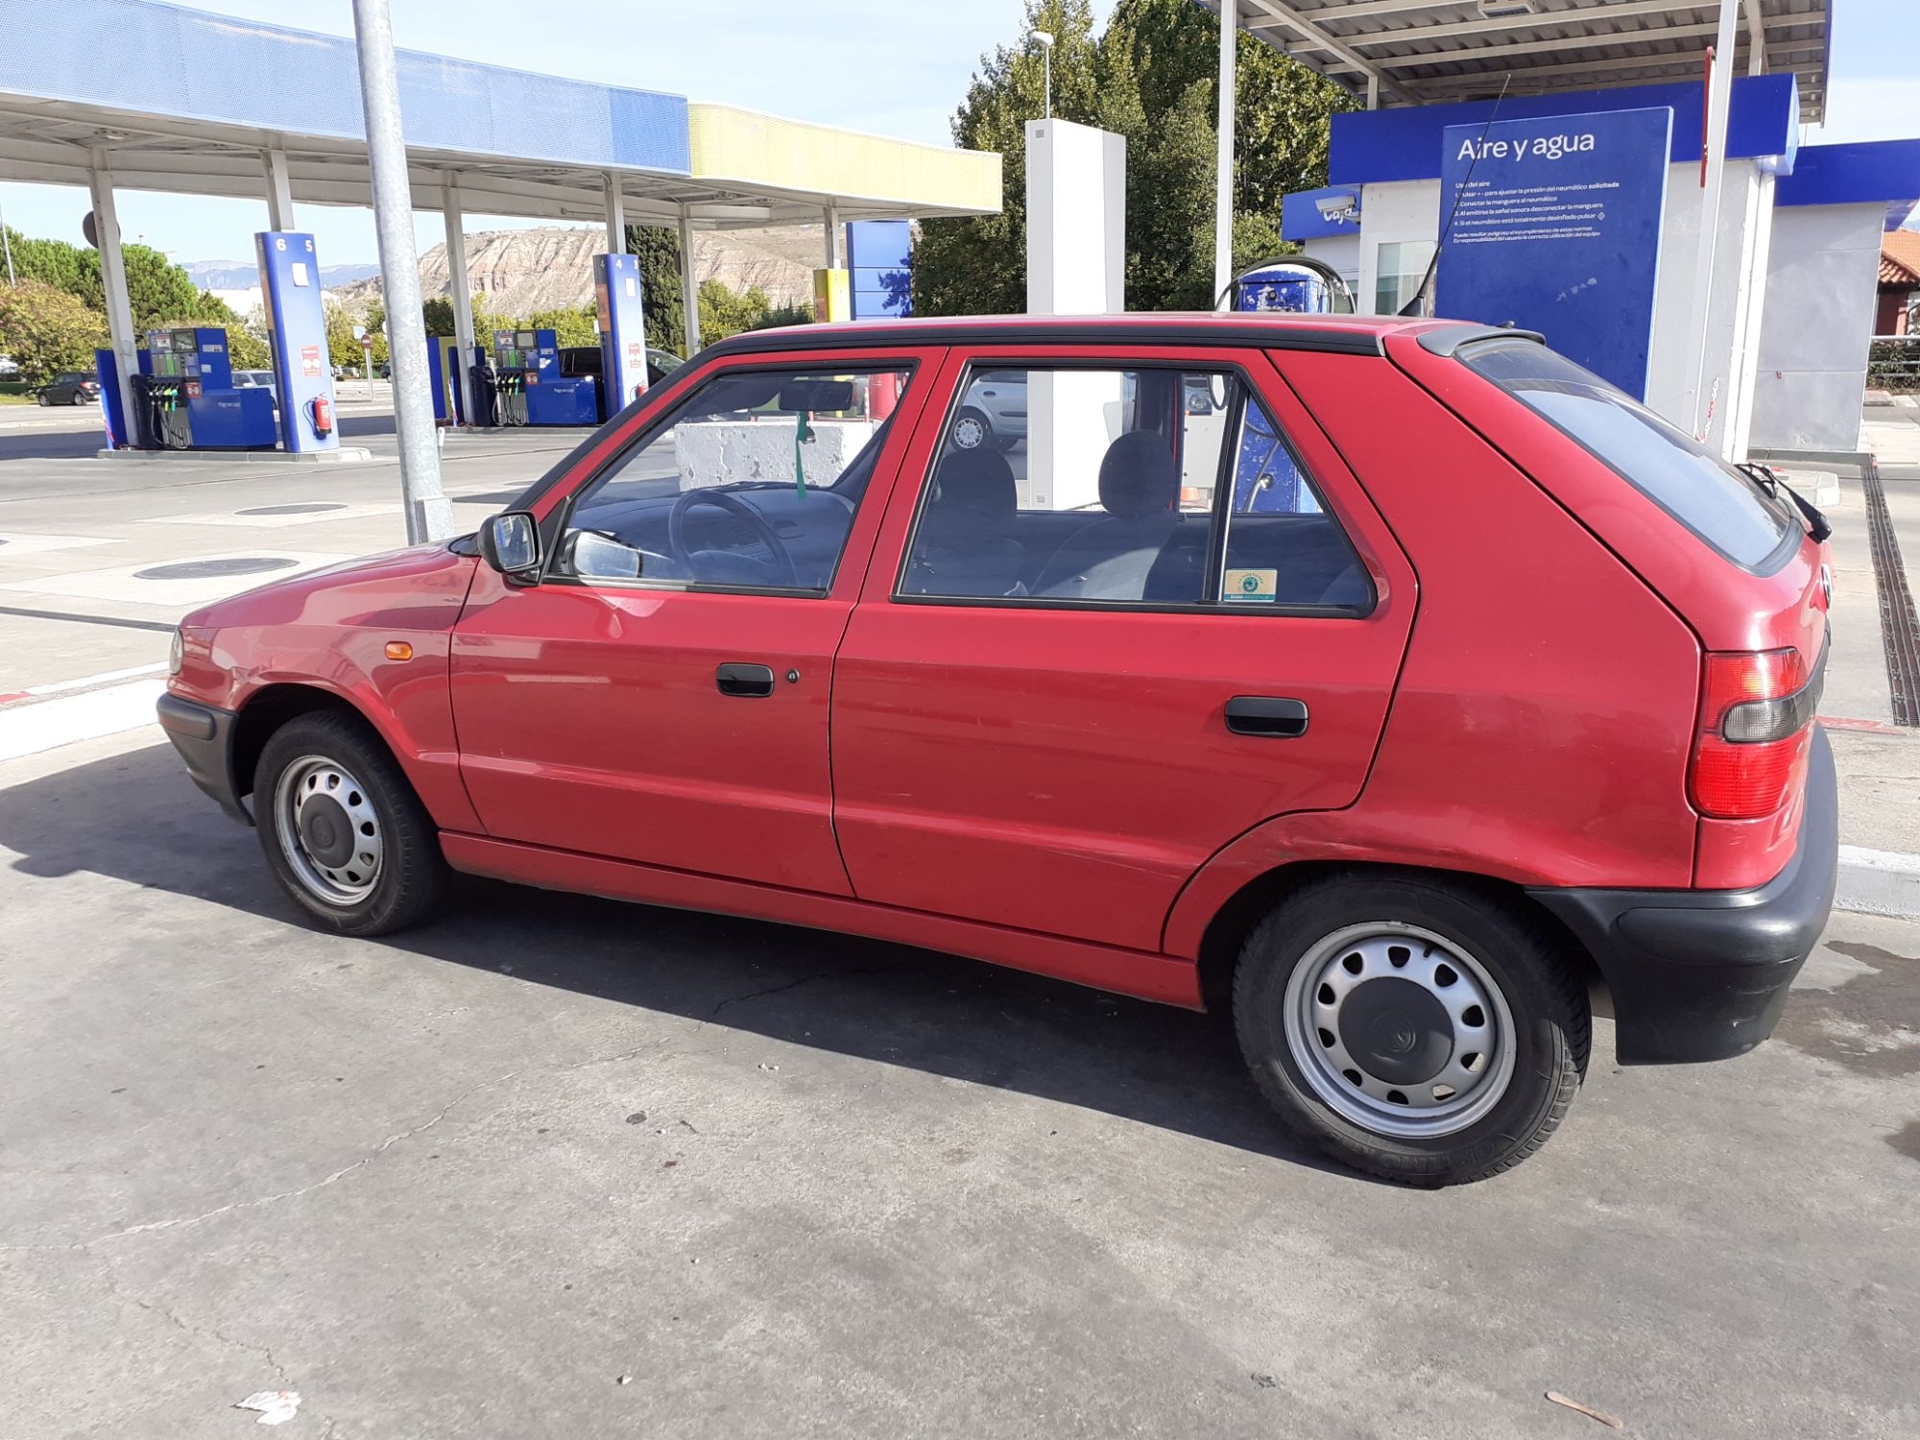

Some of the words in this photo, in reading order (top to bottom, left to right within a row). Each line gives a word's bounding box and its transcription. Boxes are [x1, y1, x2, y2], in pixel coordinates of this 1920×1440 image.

[1457, 138, 1508, 160] Aire
[1512, 138, 1528, 162] y
[1532, 133, 1595, 160] agua
[1524, 187, 1546, 195] presión
[1588, 181, 1619, 189] solicitada
[276, 238, 287, 251] 6
[305, 239, 313, 252] 5
[615, 259, 622, 270] 4
